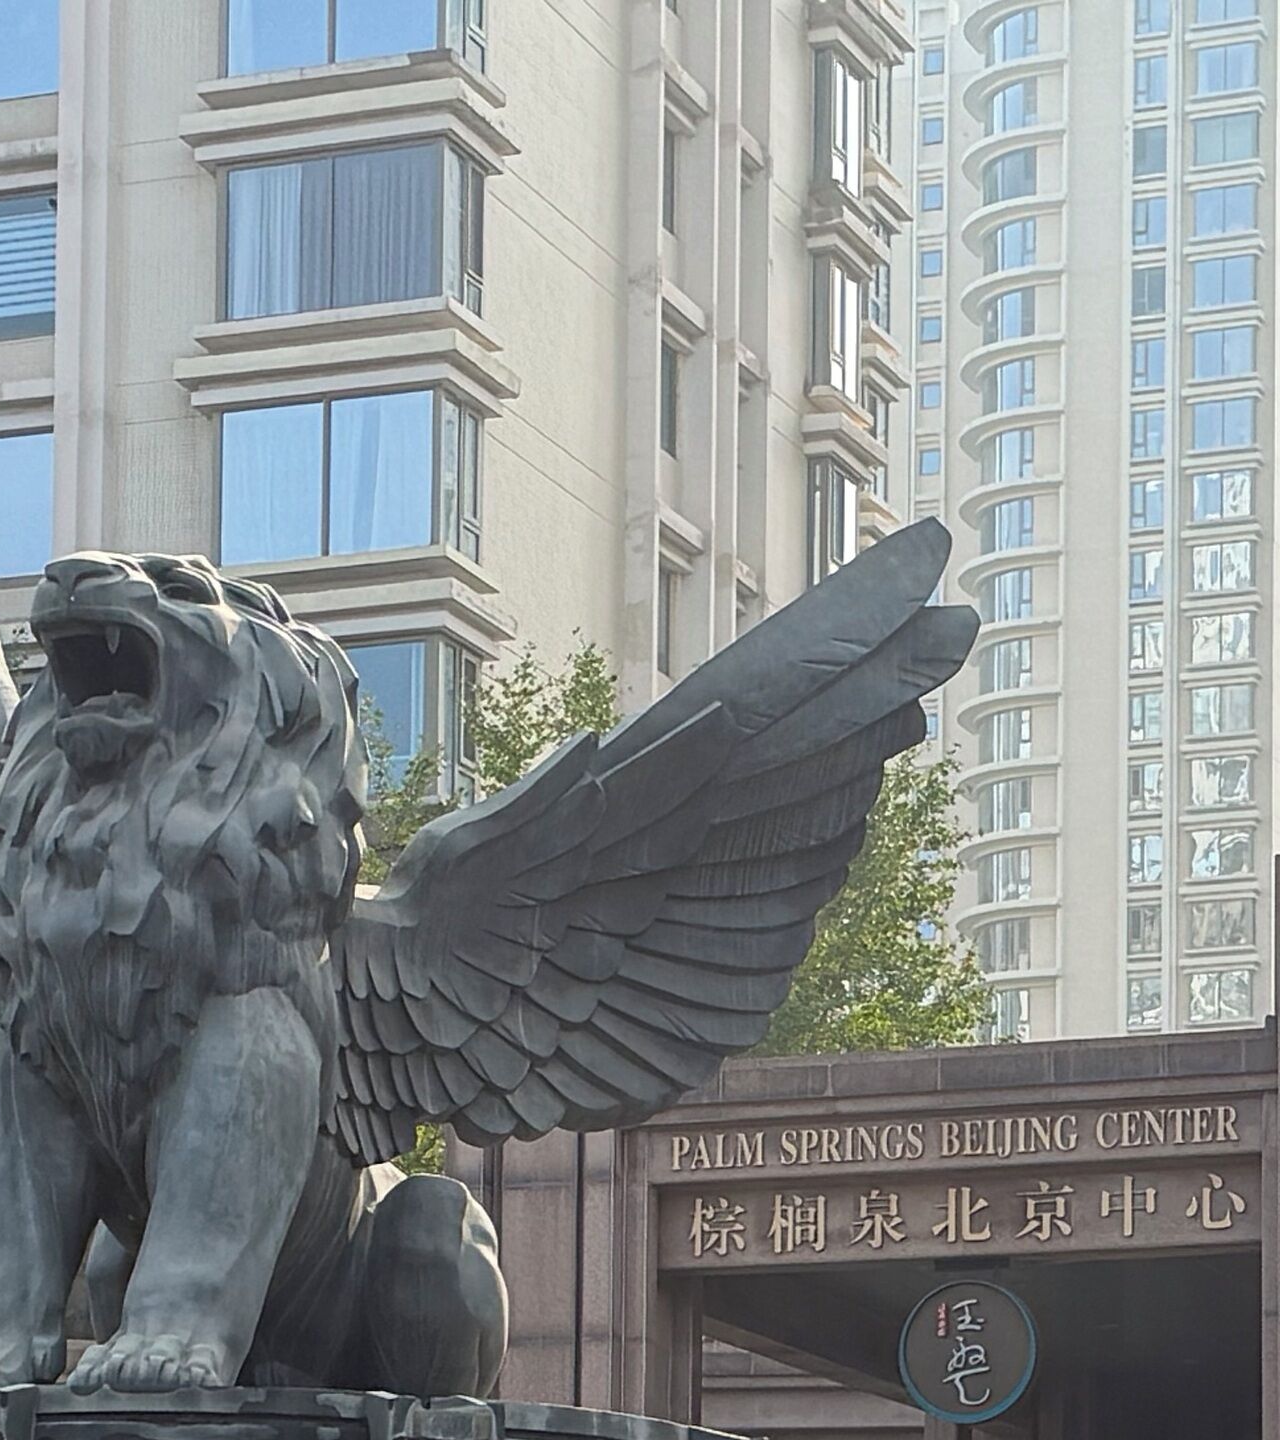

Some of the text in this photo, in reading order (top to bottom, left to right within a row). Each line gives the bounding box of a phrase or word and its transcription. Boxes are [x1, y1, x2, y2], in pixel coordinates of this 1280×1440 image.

[671, 1105, 1240, 1171] PALM SPRINGS BEIJING CENTER
[688, 1173, 1247, 1257] 棕榈泉北京中心
